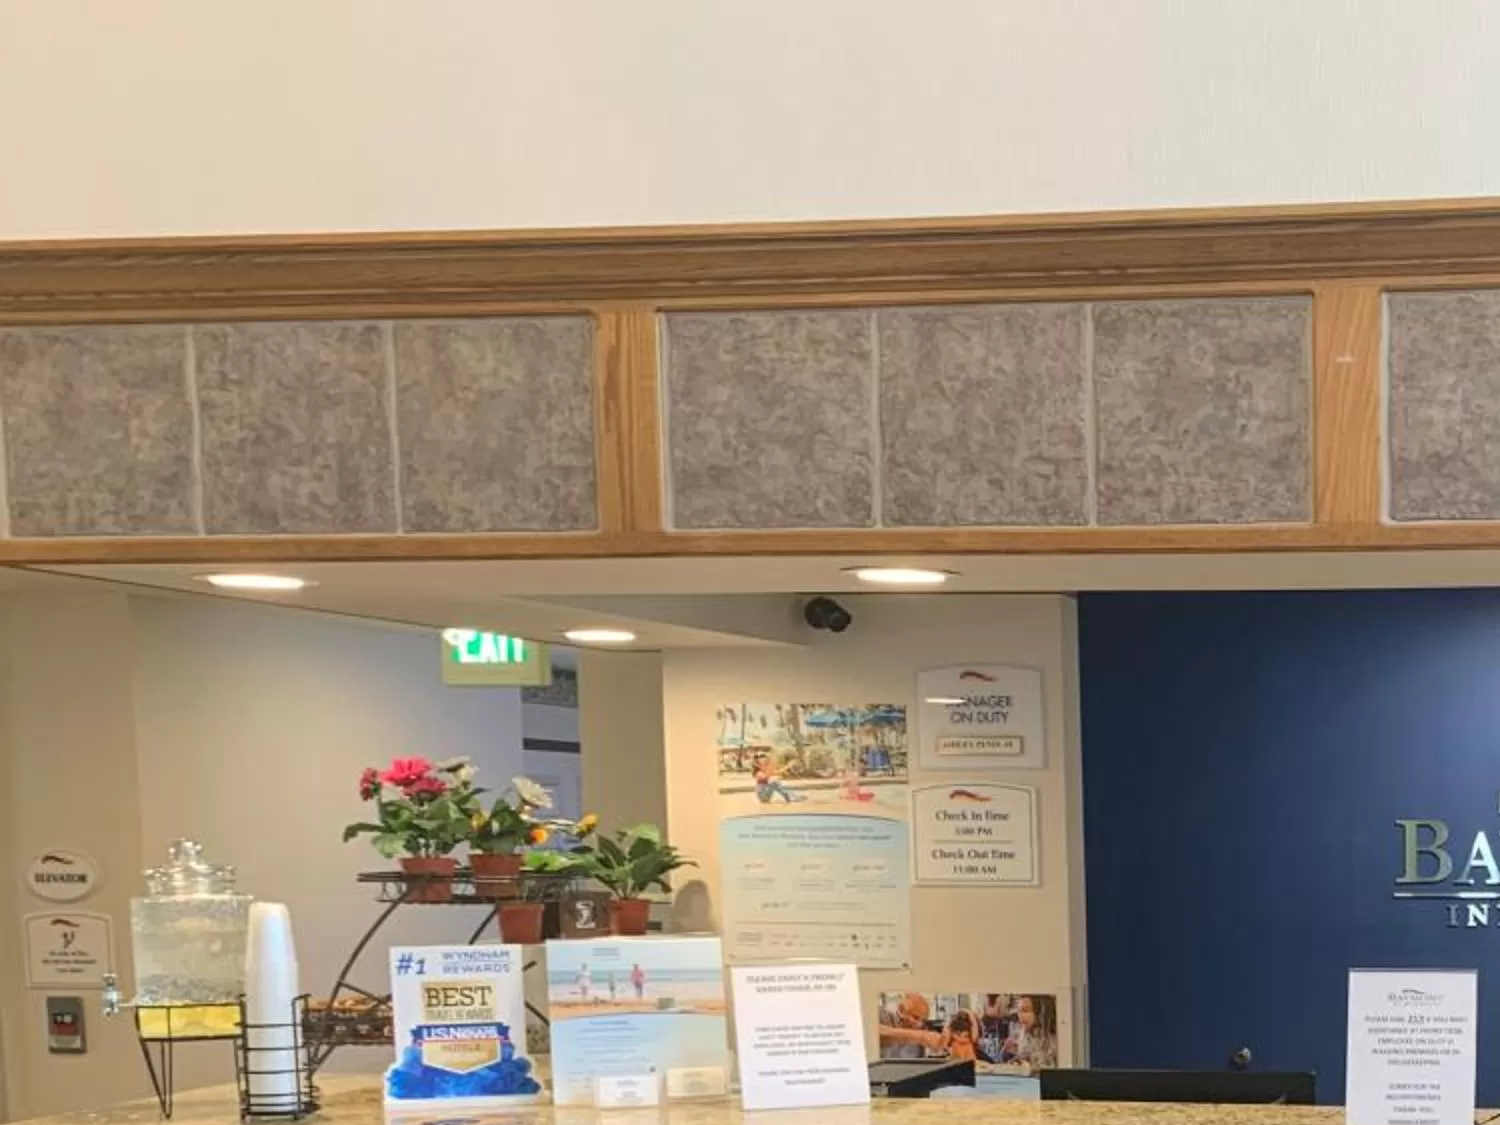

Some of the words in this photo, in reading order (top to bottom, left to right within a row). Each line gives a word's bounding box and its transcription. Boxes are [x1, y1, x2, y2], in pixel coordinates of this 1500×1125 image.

[951, 711, 973, 724] ON
[977, 711, 1009, 724] DUTY
[935, 809, 968, 822] Check
[971, 810, 982, 821] In
[985, 809, 1009, 821] Time
[931, 849, 965, 860] Check
[967, 849, 989, 860] Out
[991, 849, 1015, 860] Time
[35, 872, 88, 884] ELEVATOR
[395, 952, 427, 976] #1
[442, 963, 511, 974] REWARDS
[424, 985, 492, 1008] BEST
